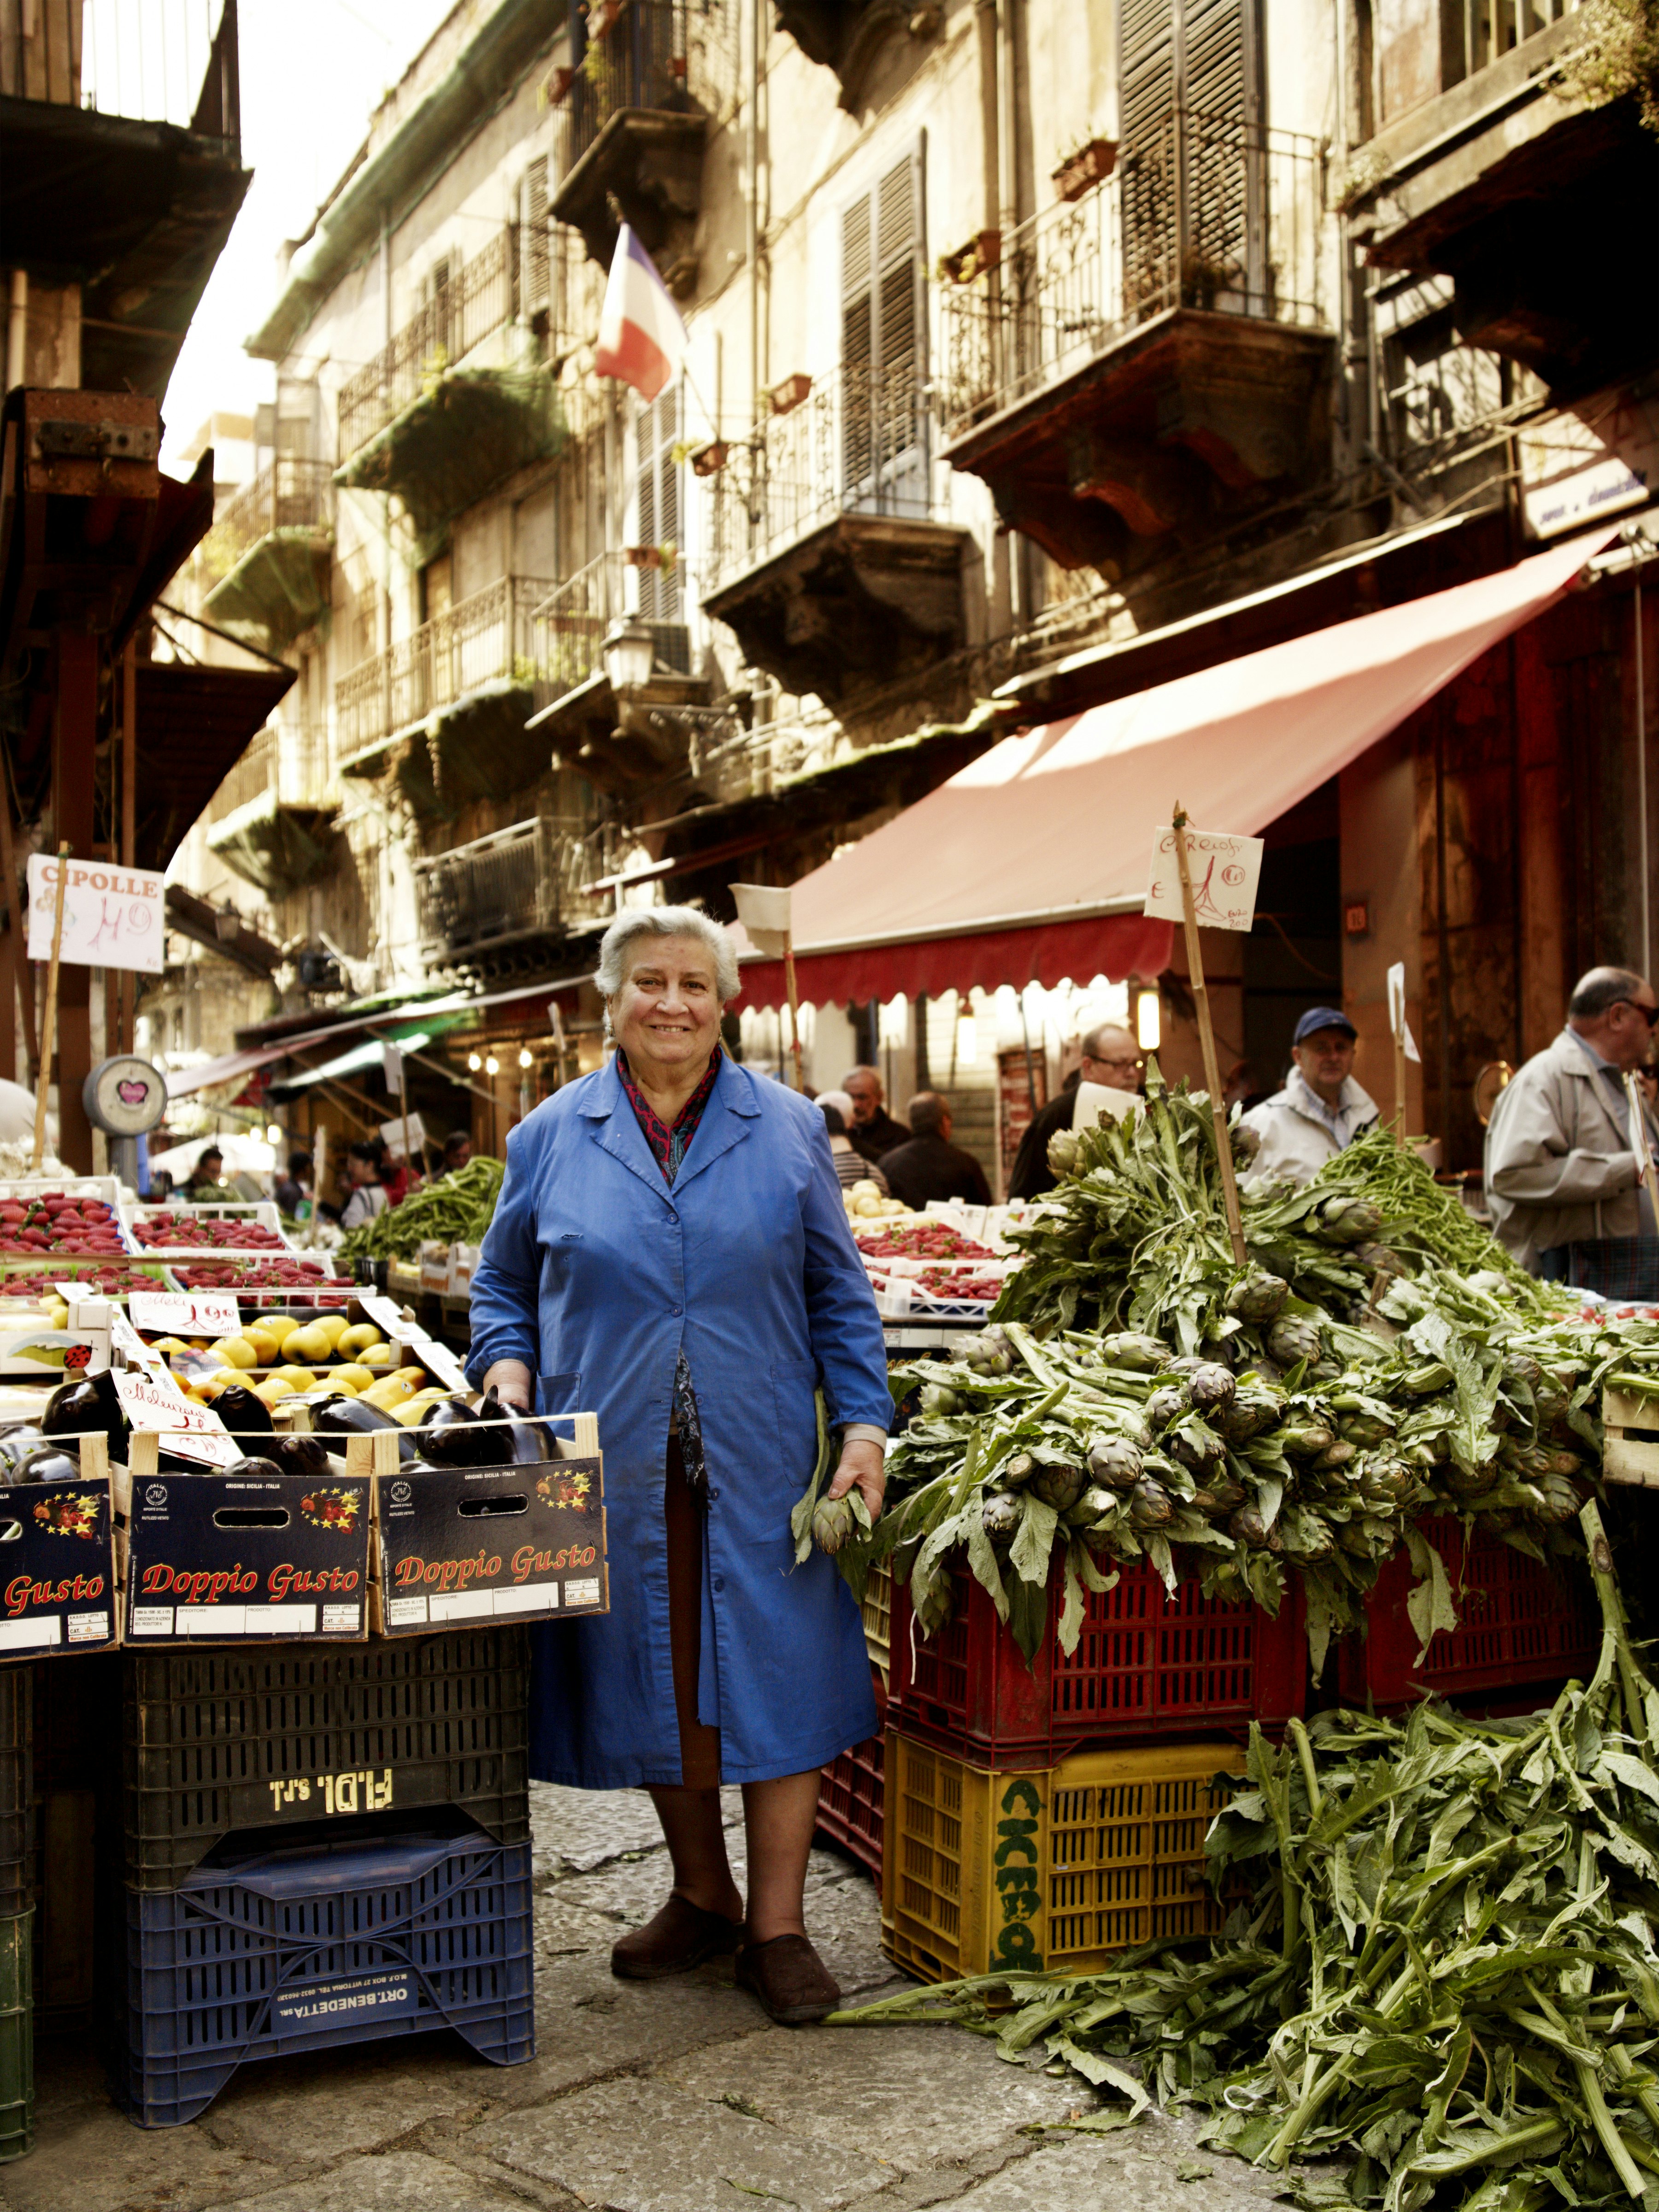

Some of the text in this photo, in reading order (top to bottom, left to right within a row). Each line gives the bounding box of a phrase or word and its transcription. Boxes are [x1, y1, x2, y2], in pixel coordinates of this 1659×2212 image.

[142, 1563, 358, 1603] Doppio Gusto
[395, 1544, 595, 1592] Doppio Gusto
[5, 1574, 103, 1617] Gusto
[270, 1769, 392, 1813] FI.DI. s.r.l.
[331, 1982, 362, 1992] VITTORIA
